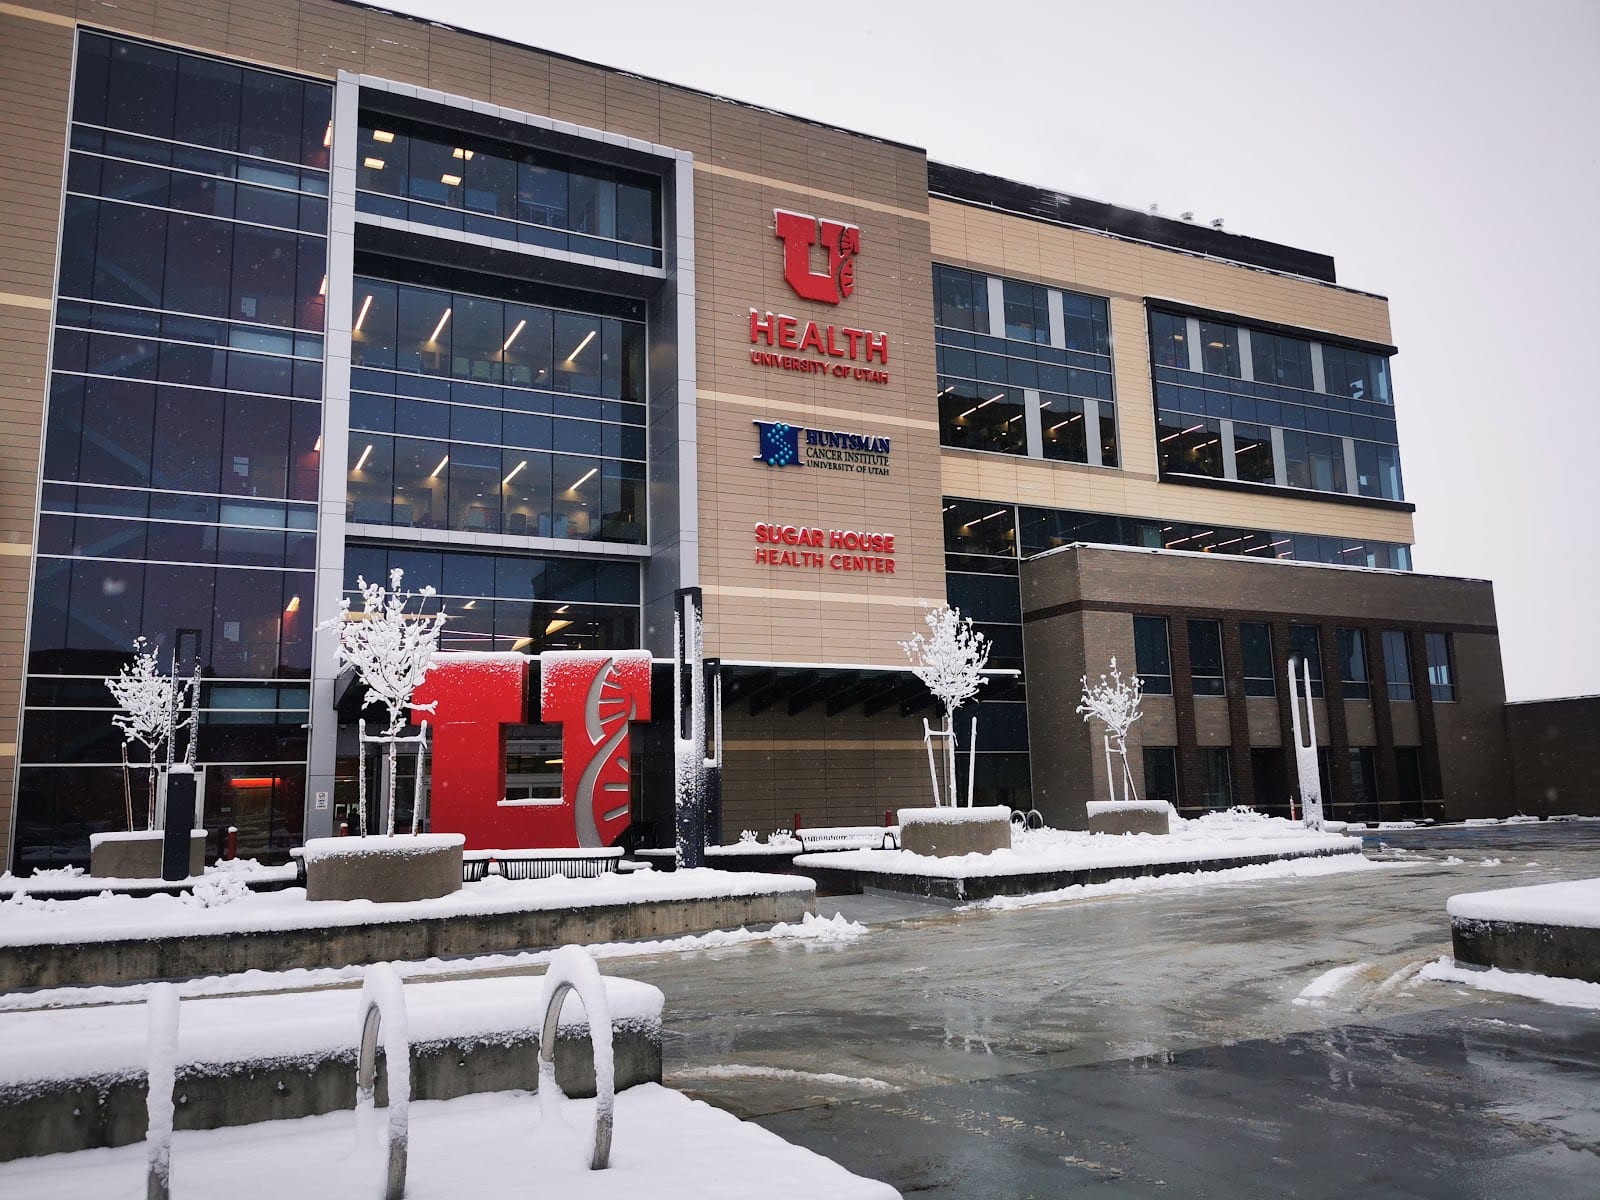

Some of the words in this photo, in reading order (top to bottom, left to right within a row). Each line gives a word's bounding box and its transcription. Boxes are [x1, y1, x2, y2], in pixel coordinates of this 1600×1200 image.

[749, 307, 888, 364] HEALTH
[751, 349, 829, 375] UNIVERSITY
[832, 364, 850, 378] OF
[853, 367, 889, 384] UTAH
[805, 428, 890, 453] HUNTSMAN
[806, 447, 844, 462] CANCER
[844, 452, 890, 466] INSTITUTE
[806, 460, 854, 472] UNIVERSITY
[856, 465, 867, 473] OF
[868, 467, 890, 476] UTAH
[755, 522, 824, 548] SUGAR
[829, 529, 895, 554] HOUSE
[755, 547, 824, 568] HEALTH
[829, 554, 896, 573] CENTER
